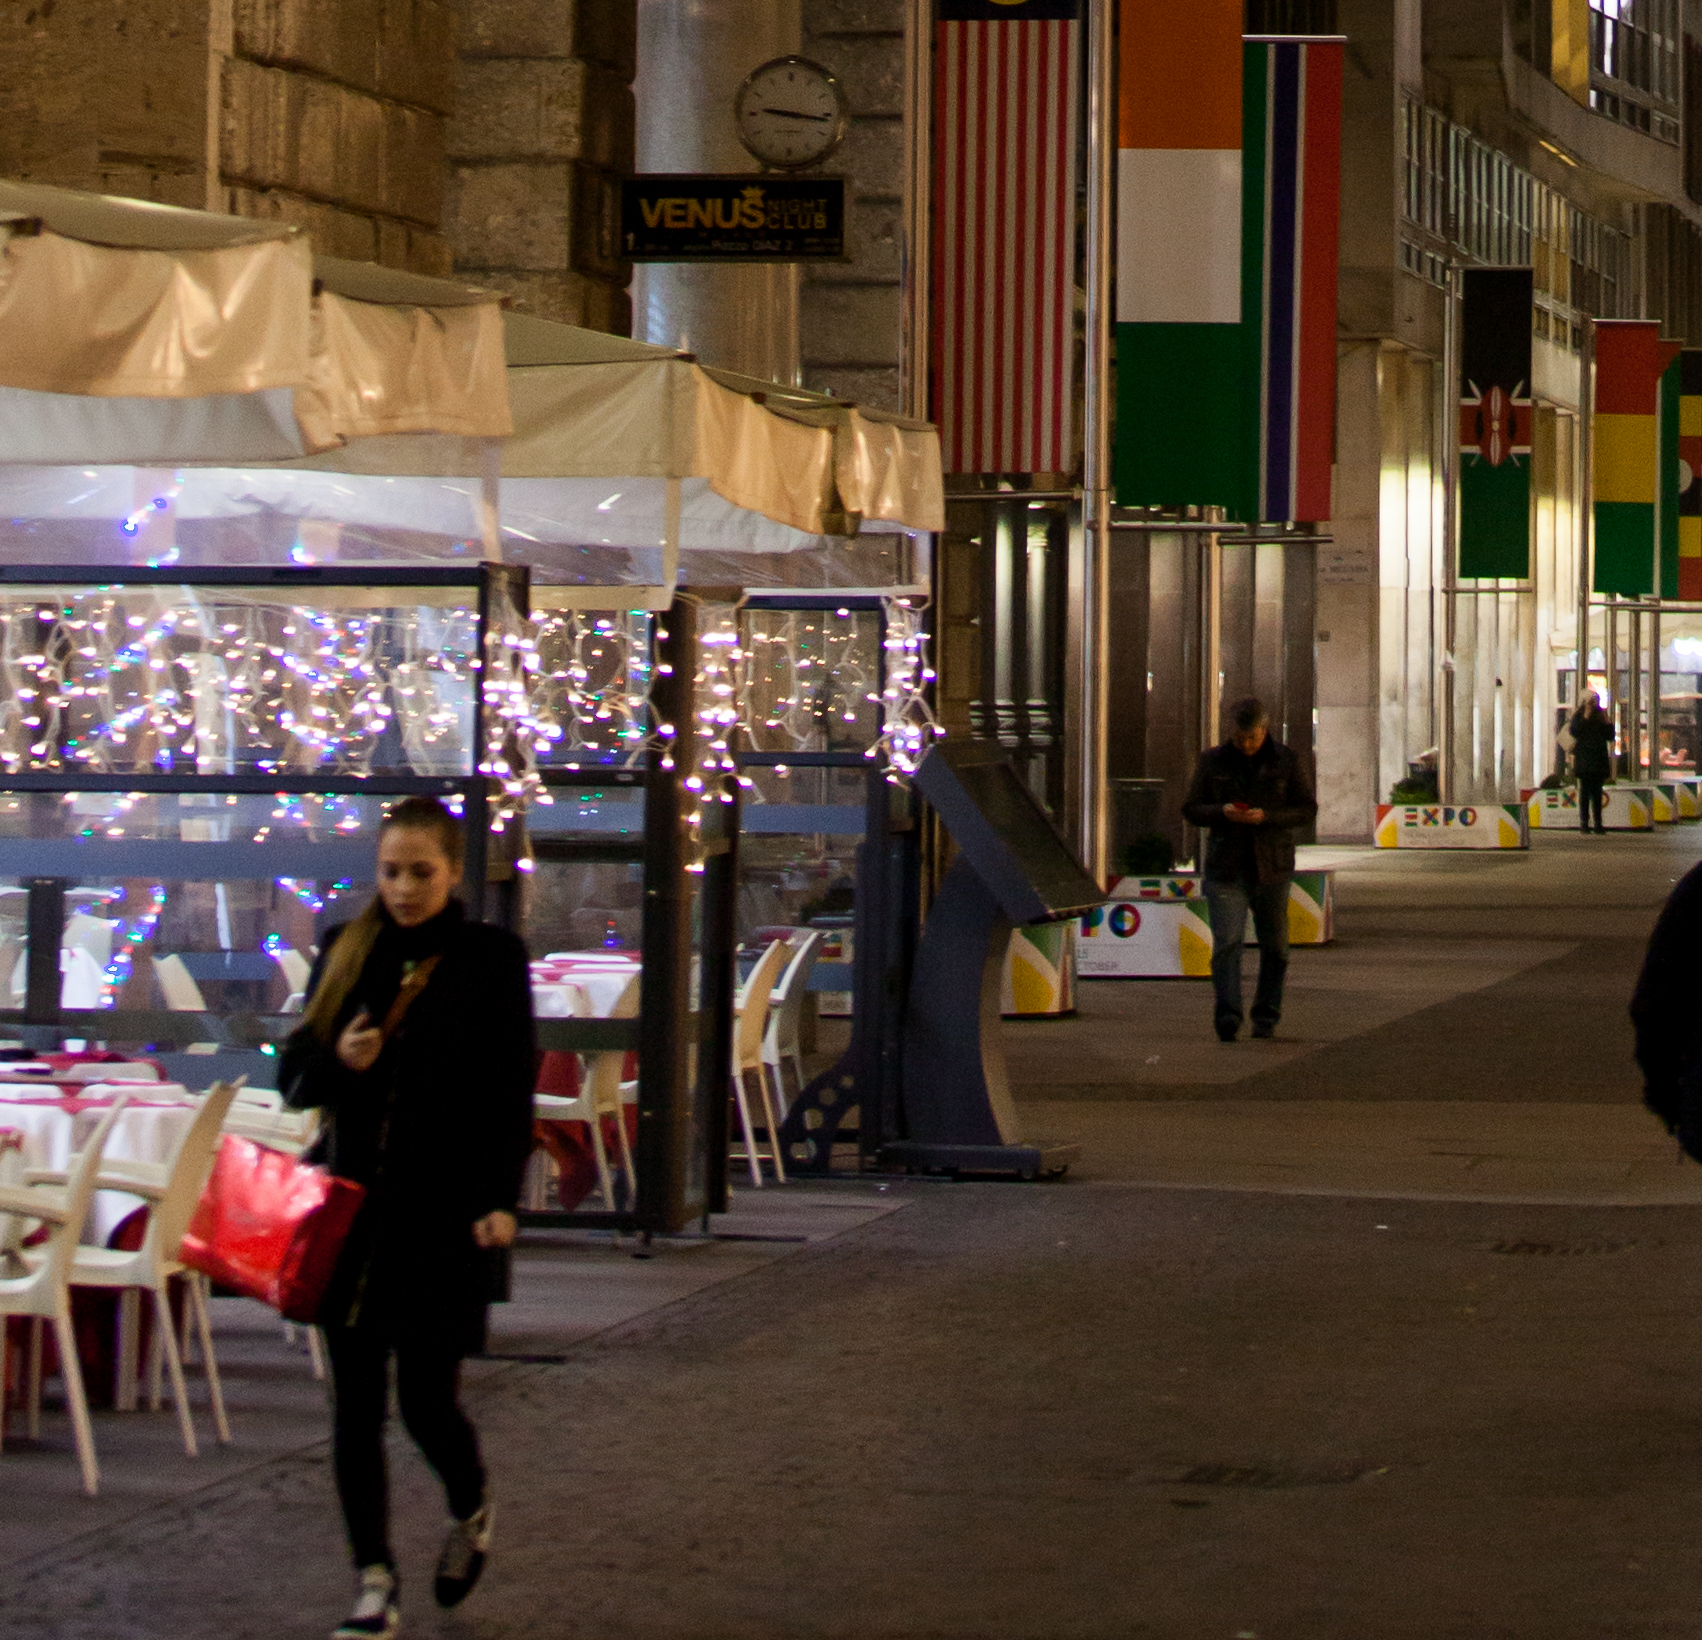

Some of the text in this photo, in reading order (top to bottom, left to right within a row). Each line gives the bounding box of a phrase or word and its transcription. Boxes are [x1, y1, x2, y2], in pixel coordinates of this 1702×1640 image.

[638, 197, 767, 229] VENUS
[767, 198, 828, 213] NIGHT
[767, 213, 828, 230] CLUB
[1404, 807, 1478, 827] EXPO
